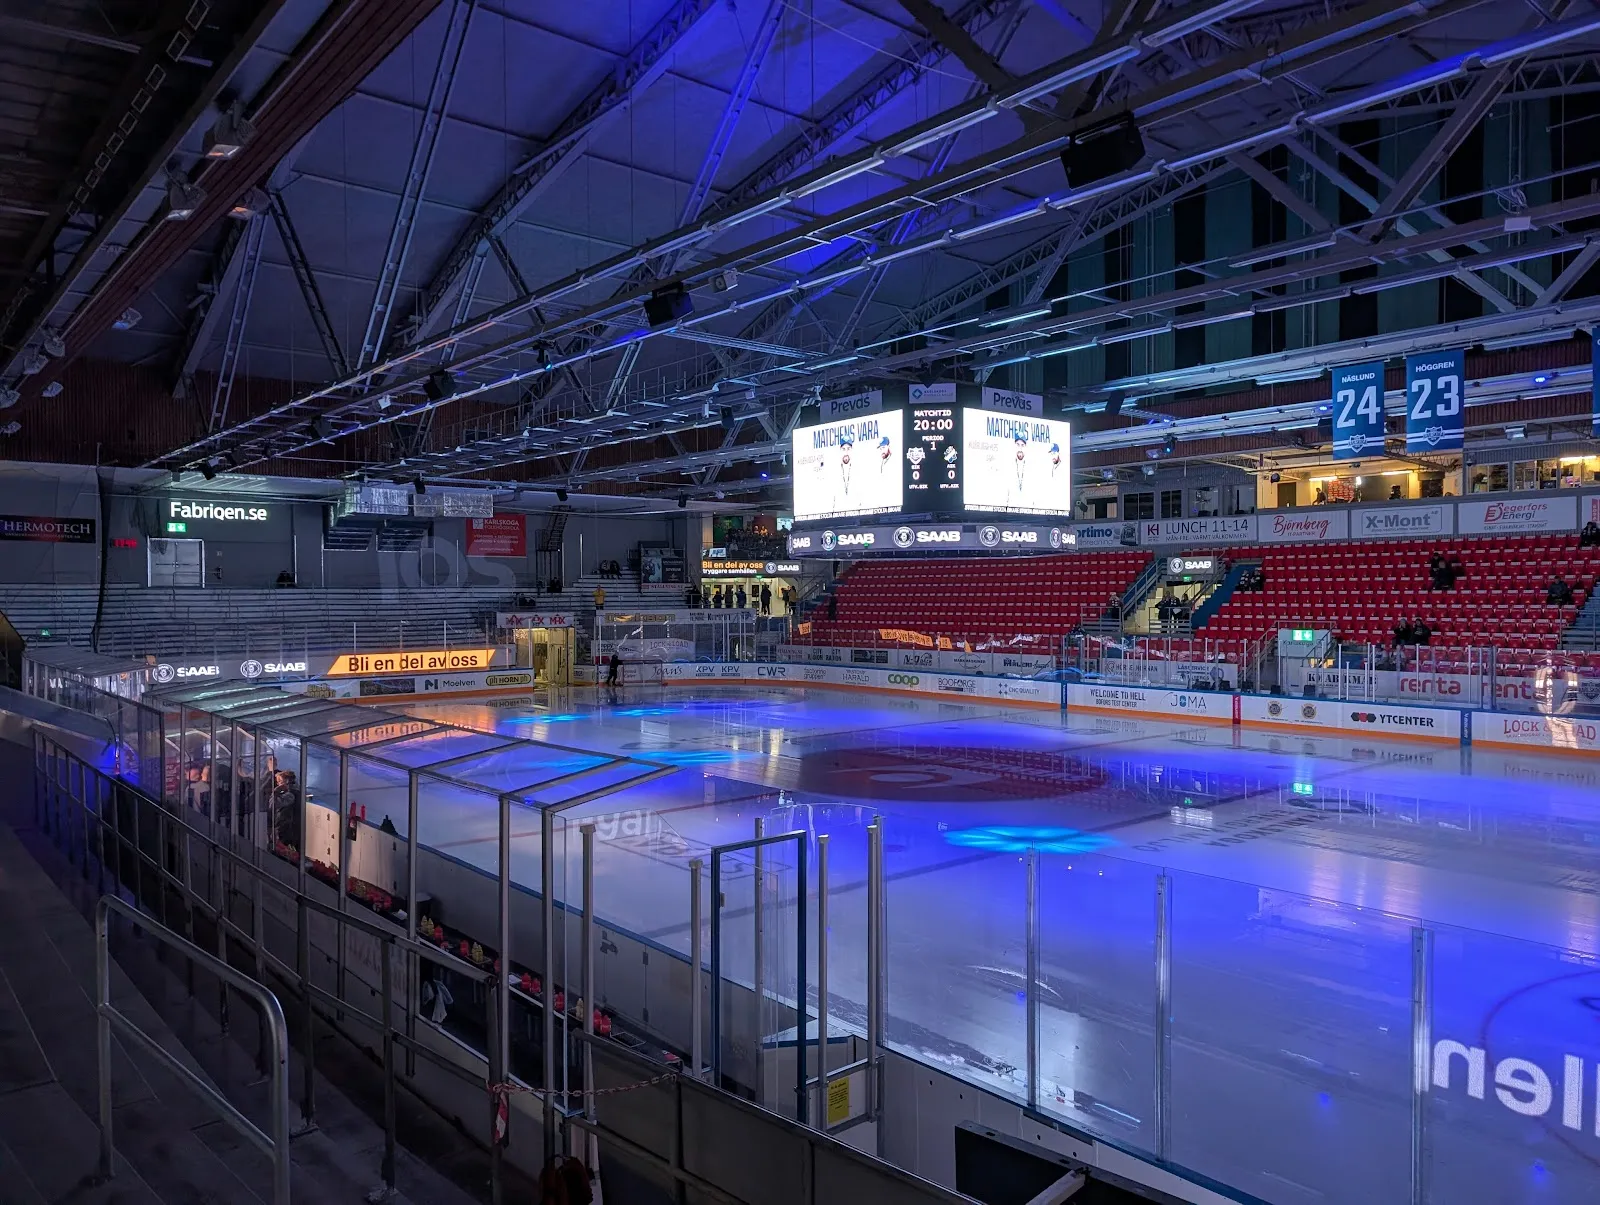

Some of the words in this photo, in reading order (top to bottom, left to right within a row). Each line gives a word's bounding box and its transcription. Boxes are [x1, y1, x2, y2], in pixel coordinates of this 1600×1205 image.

[1415, 361, 1455, 373] HÖGGREN
[1341, 372, 1376, 383] NÄSLUND
[993, 392, 1032, 411] Prevas
[1410, 375, 1460, 420] 23
[831, 396, 871, 414] Prevas
[1336, 386, 1381, 428] 24
[913, 419, 953, 430] 20:00
[986, 416, 1028, 441] MATCHENS
[1031, 422, 1051, 443] VARA
[813, 424, 855, 449] MATCHENS
[857, 420, 879, 441] VARA
[930, 441, 937, 451] 1
[912, 471, 920, 480] 0
[948, 470, 956, 479] 0
[170, 502, 268, 520] Fabriqen.se
[1502, 510, 1536, 520] Energi
[1166, 521, 1207, 534] LUNCH
[1212, 519, 1249, 532] 11-14
[1273, 515, 1331, 538] Björnberg
[1365, 513, 1431, 528] X-Mont
[792, 537, 811, 548] SAAB
[837, 533, 875, 545] SAAB
[916, 531, 961, 542] SAAB
[1001, 531, 1037, 542] SAAB
[1061, 533, 1076, 544] SAAB
[702, 561, 713, 569] Bli
[725, 561, 738, 569] del
[1185, 561, 1211, 570] SAAB
[264, 662, 306, 673] SAAB
[349, 656, 369, 672] Bli
[374, 658, 394, 671] en
[400, 654, 424, 670] del
[428, 656, 446, 668] av
[451, 655, 478, 668] oss
[695, 665, 715, 673] KPV
[721, 665, 740, 673] KPV
[177, 665, 220, 677] SAAB
[757, 666, 786, 676] CWR
[442, 679, 476, 687] Moelven
[842, 674, 870, 682] HARALD
[888, 674, 920, 687] coop
[1400, 677, 1461, 695] renta
[1090, 688, 1119, 699] WELCOME
[1121, 690, 1129, 699] TO
[1130, 691, 1146, 701] HELL
[1171, 694, 1207, 709] JOMA
[1380, 714, 1434, 728] YTCENTER
[1503, 719, 1540, 734] LOCK
